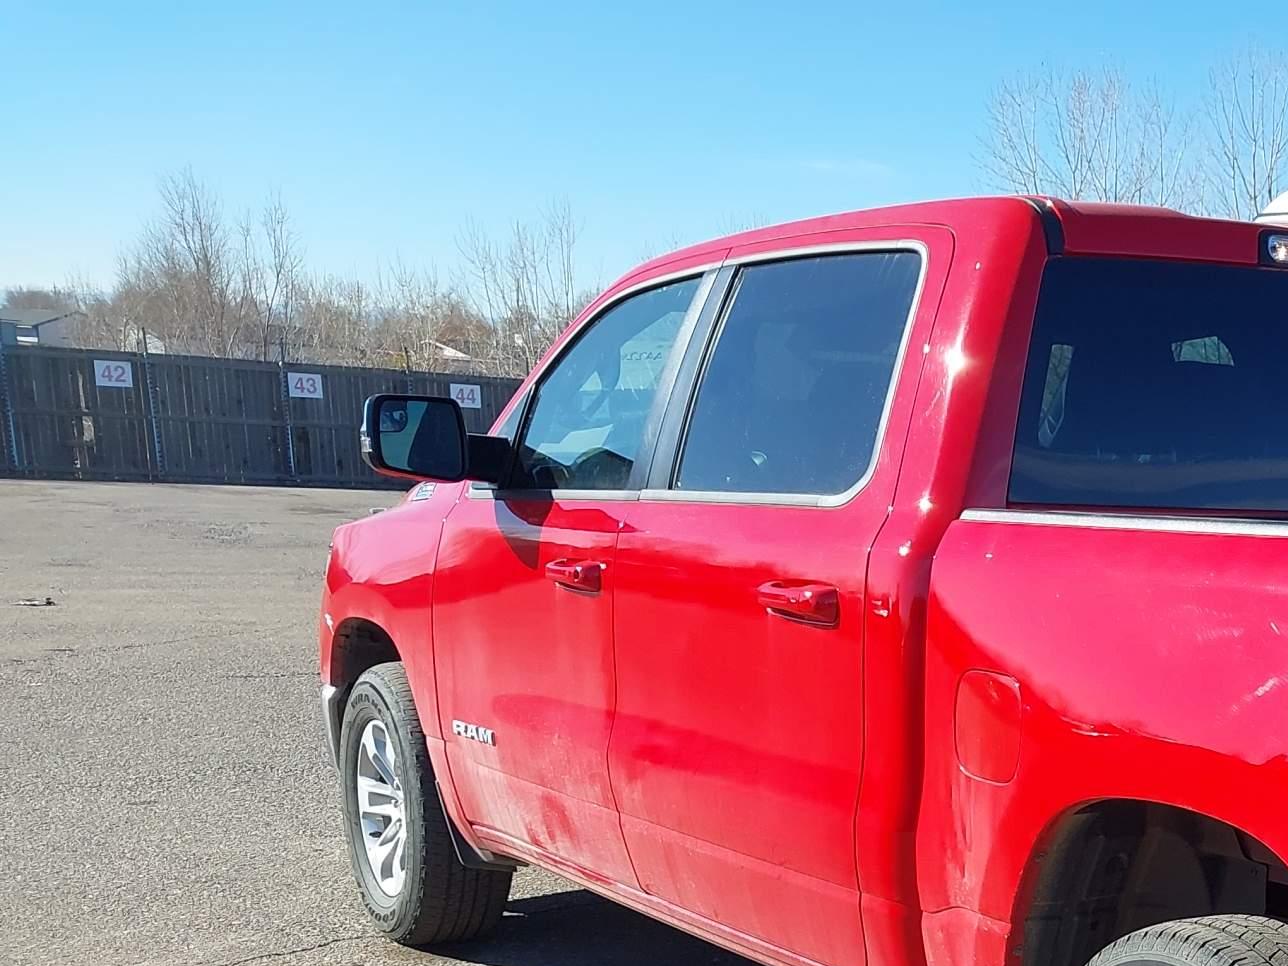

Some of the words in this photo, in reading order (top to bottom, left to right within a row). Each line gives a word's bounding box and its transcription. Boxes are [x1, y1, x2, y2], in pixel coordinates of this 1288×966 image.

[101, 364, 127, 382] 42
[295, 376, 317, 394] 43
[456, 388, 476, 403] 44
[452, 719, 496, 747] RAM
